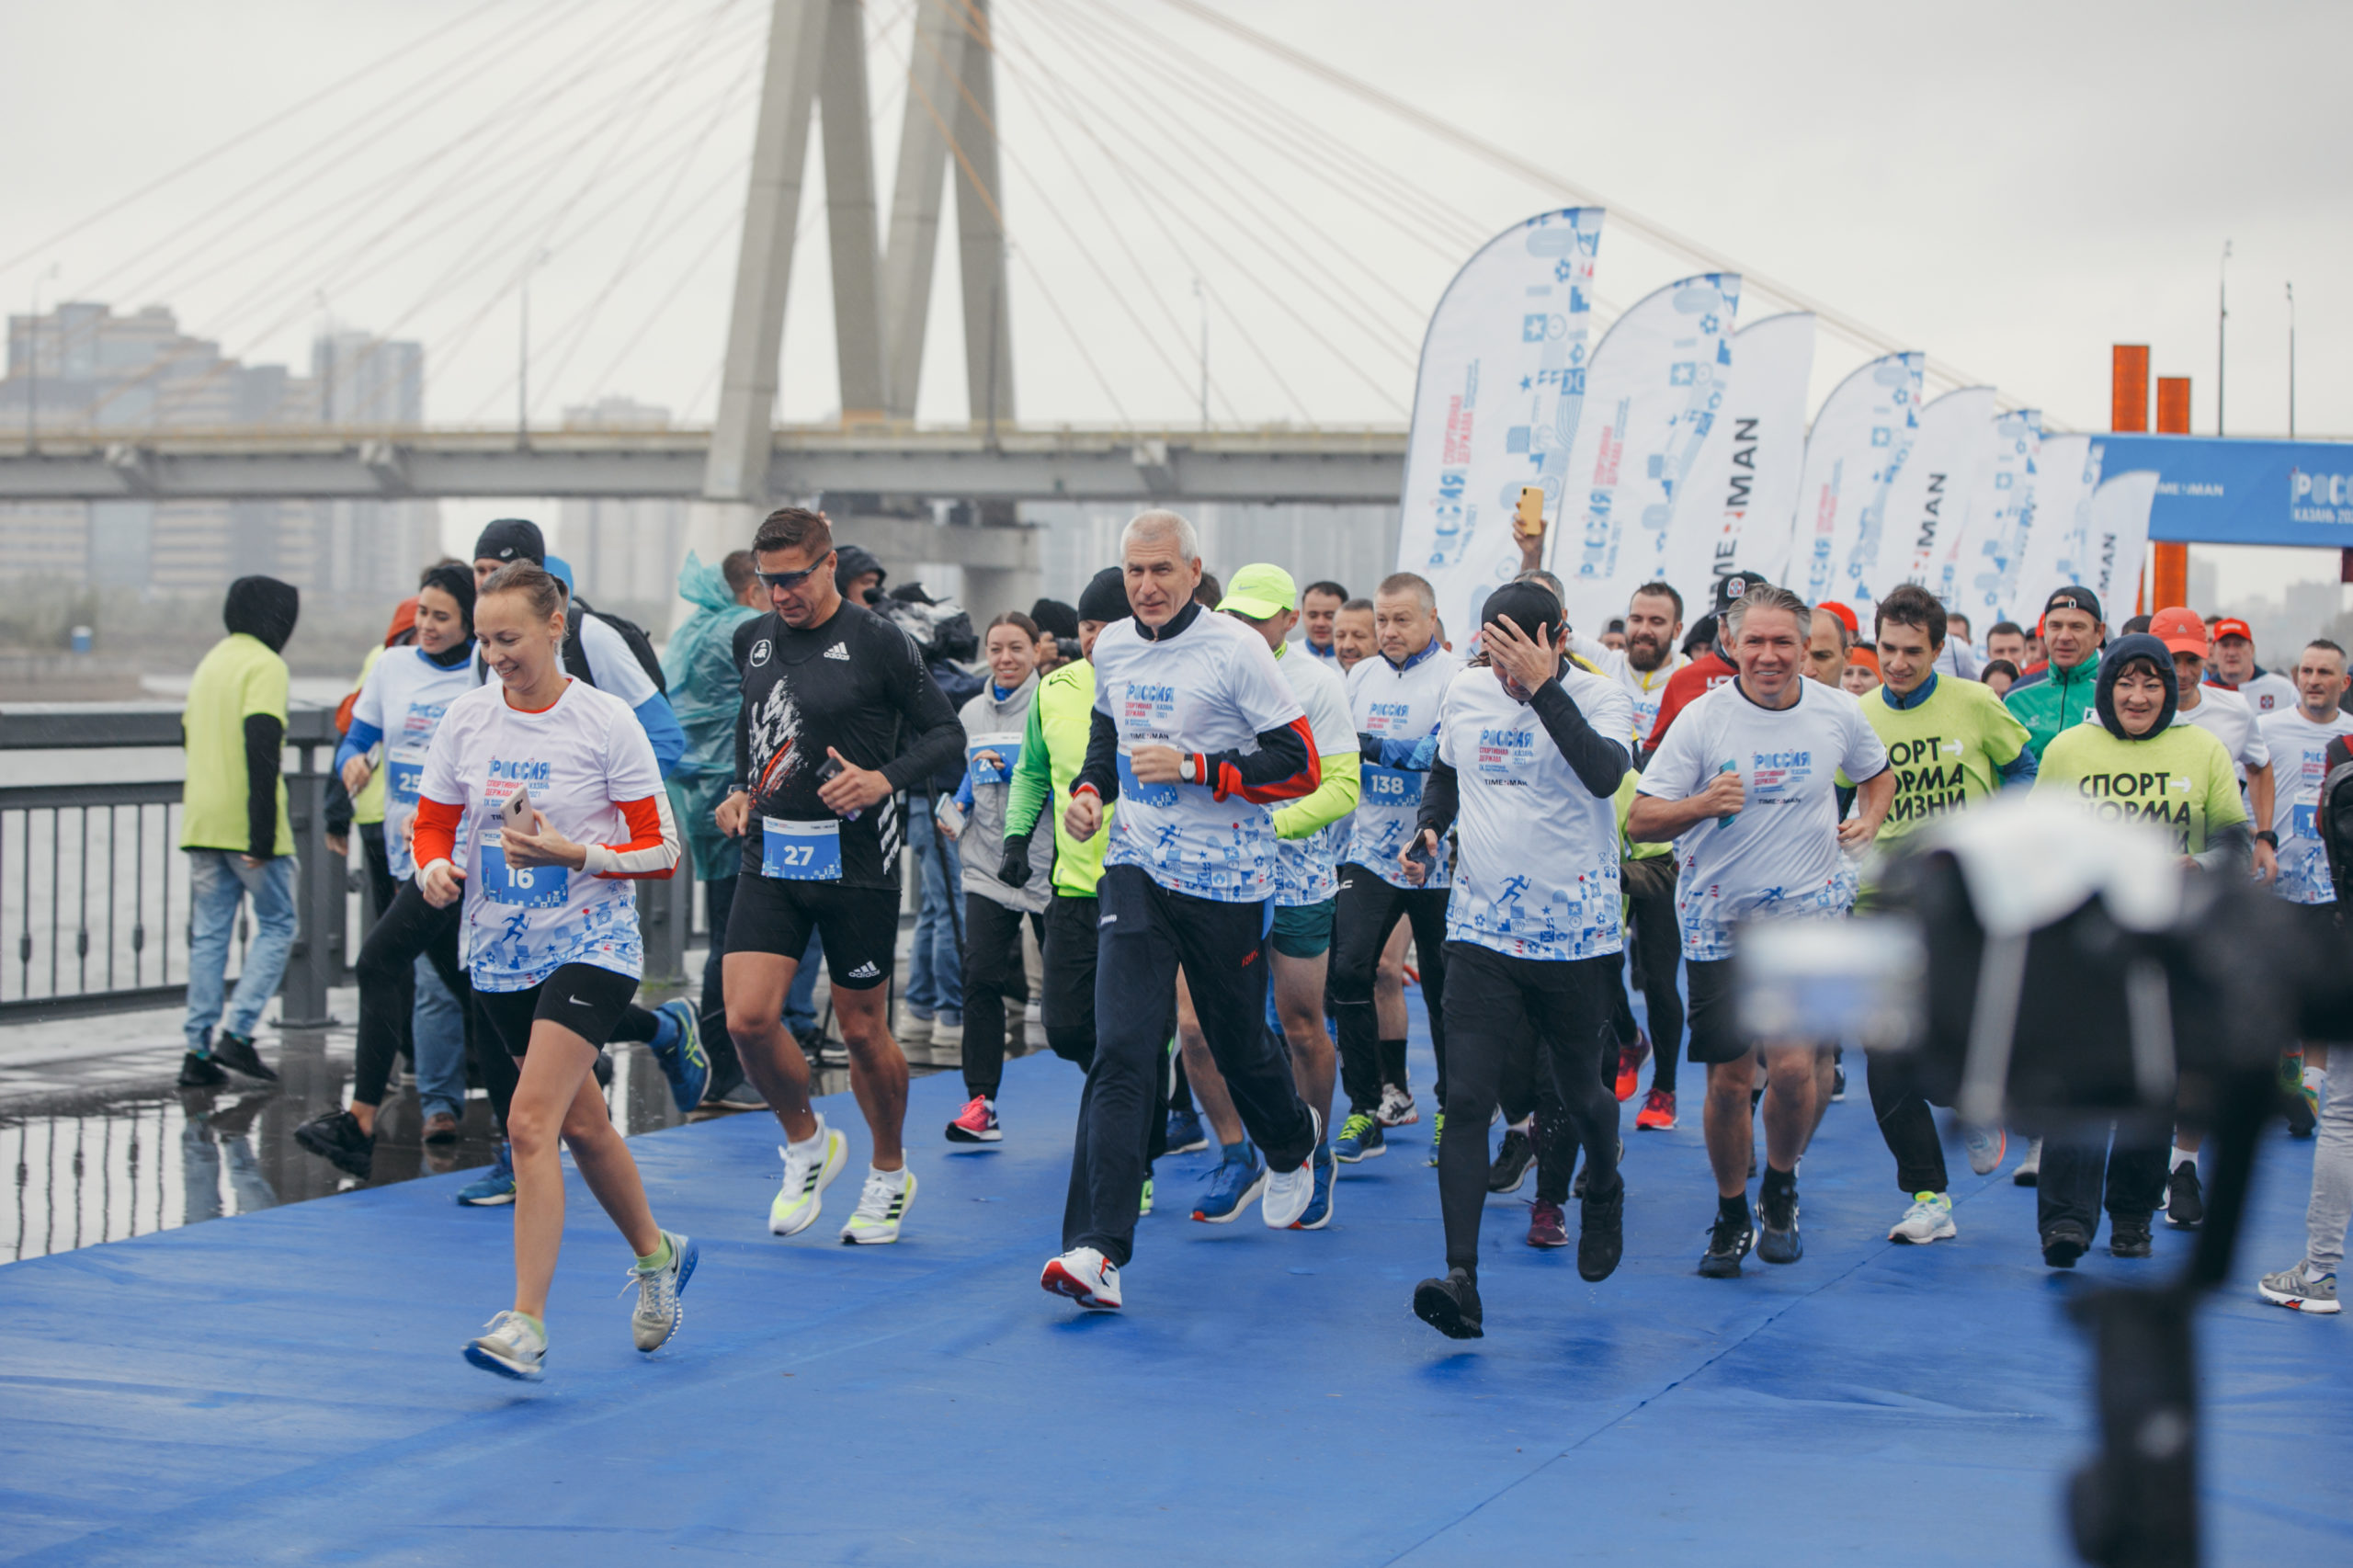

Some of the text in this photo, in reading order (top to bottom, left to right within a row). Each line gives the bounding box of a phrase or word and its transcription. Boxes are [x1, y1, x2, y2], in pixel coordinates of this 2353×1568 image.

[1428, 468, 1468, 569] РОССИЯ
[1580, 488, 1613, 579] РОССИЯ
[824, 651, 850, 661] adidas
[1125, 685, 1175, 702] РОССИЯ
[1369, 703, 1410, 717] РОССИЯ
[1480, 729, 1535, 748] РОССИЯ
[1479, 746, 1509, 756] СПОРТИВНАЯ
[1479, 755, 1502, 763] ДЕРЖАВА
[1754, 751, 1812, 769] РОССИЯ
[1888, 736, 1941, 767] ОРТ
[487, 759, 551, 780] РОССИЯ
[1370, 775, 1404, 794] 138
[2078, 772, 2171, 799] СПОРТ
[1884, 788, 1967, 823] ИЗНИ
[784, 845, 814, 866] 27
[506, 864, 535, 889] 16
[848, 969, 881, 978] adidas
